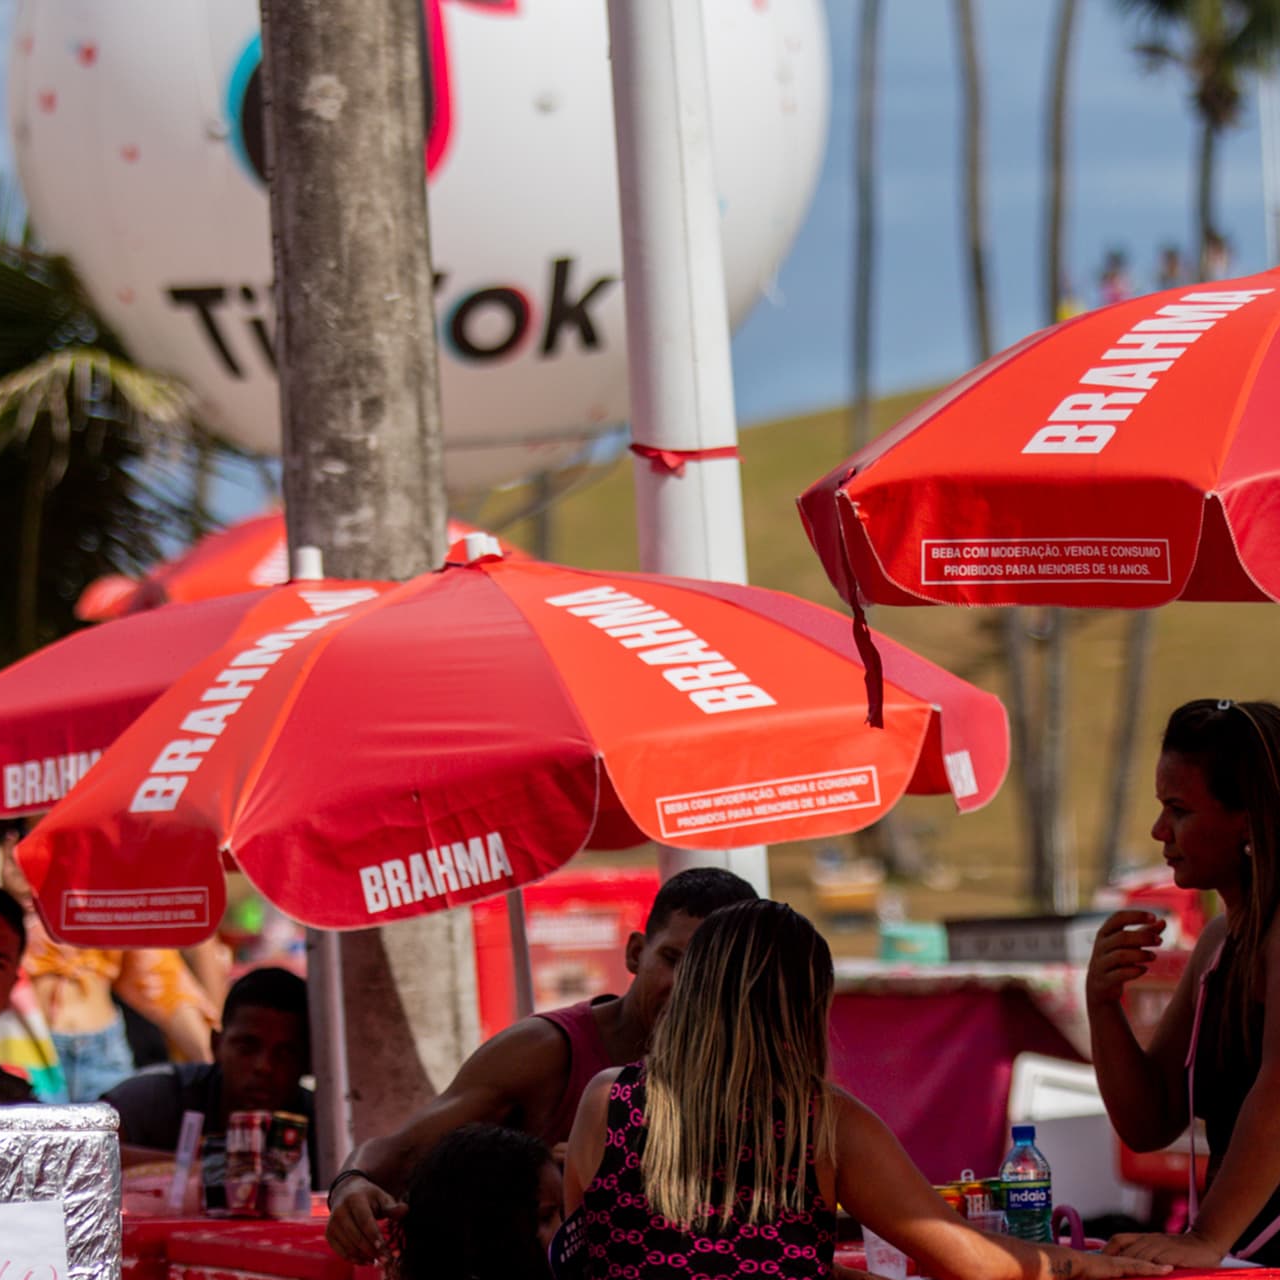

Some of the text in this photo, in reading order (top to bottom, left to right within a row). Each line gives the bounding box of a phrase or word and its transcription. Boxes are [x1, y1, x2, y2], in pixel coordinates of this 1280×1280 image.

[164, 255, 622, 382] Tiok
[1020, 288, 1276, 455] BRAHMA
[932, 547, 961, 559] BEBA
[963, 547, 989, 558] COM
[1064, 546, 1101, 557] VENDA
[1102, 546, 1109, 557] E
[1111, 546, 1161, 558] CONSUMO
[944, 564, 1003, 576] PROIBIDOS
[1006, 564, 1036, 576] PARA
[1038, 564, 1090, 575] MENORES
[1093, 564, 1106, 574] DE
[1108, 564, 1119, 575] 18
[544, 586, 778, 714] BRAHMA
[3, 749, 104, 809] BRAH
[358, 831, 513, 914] BRAHMA
